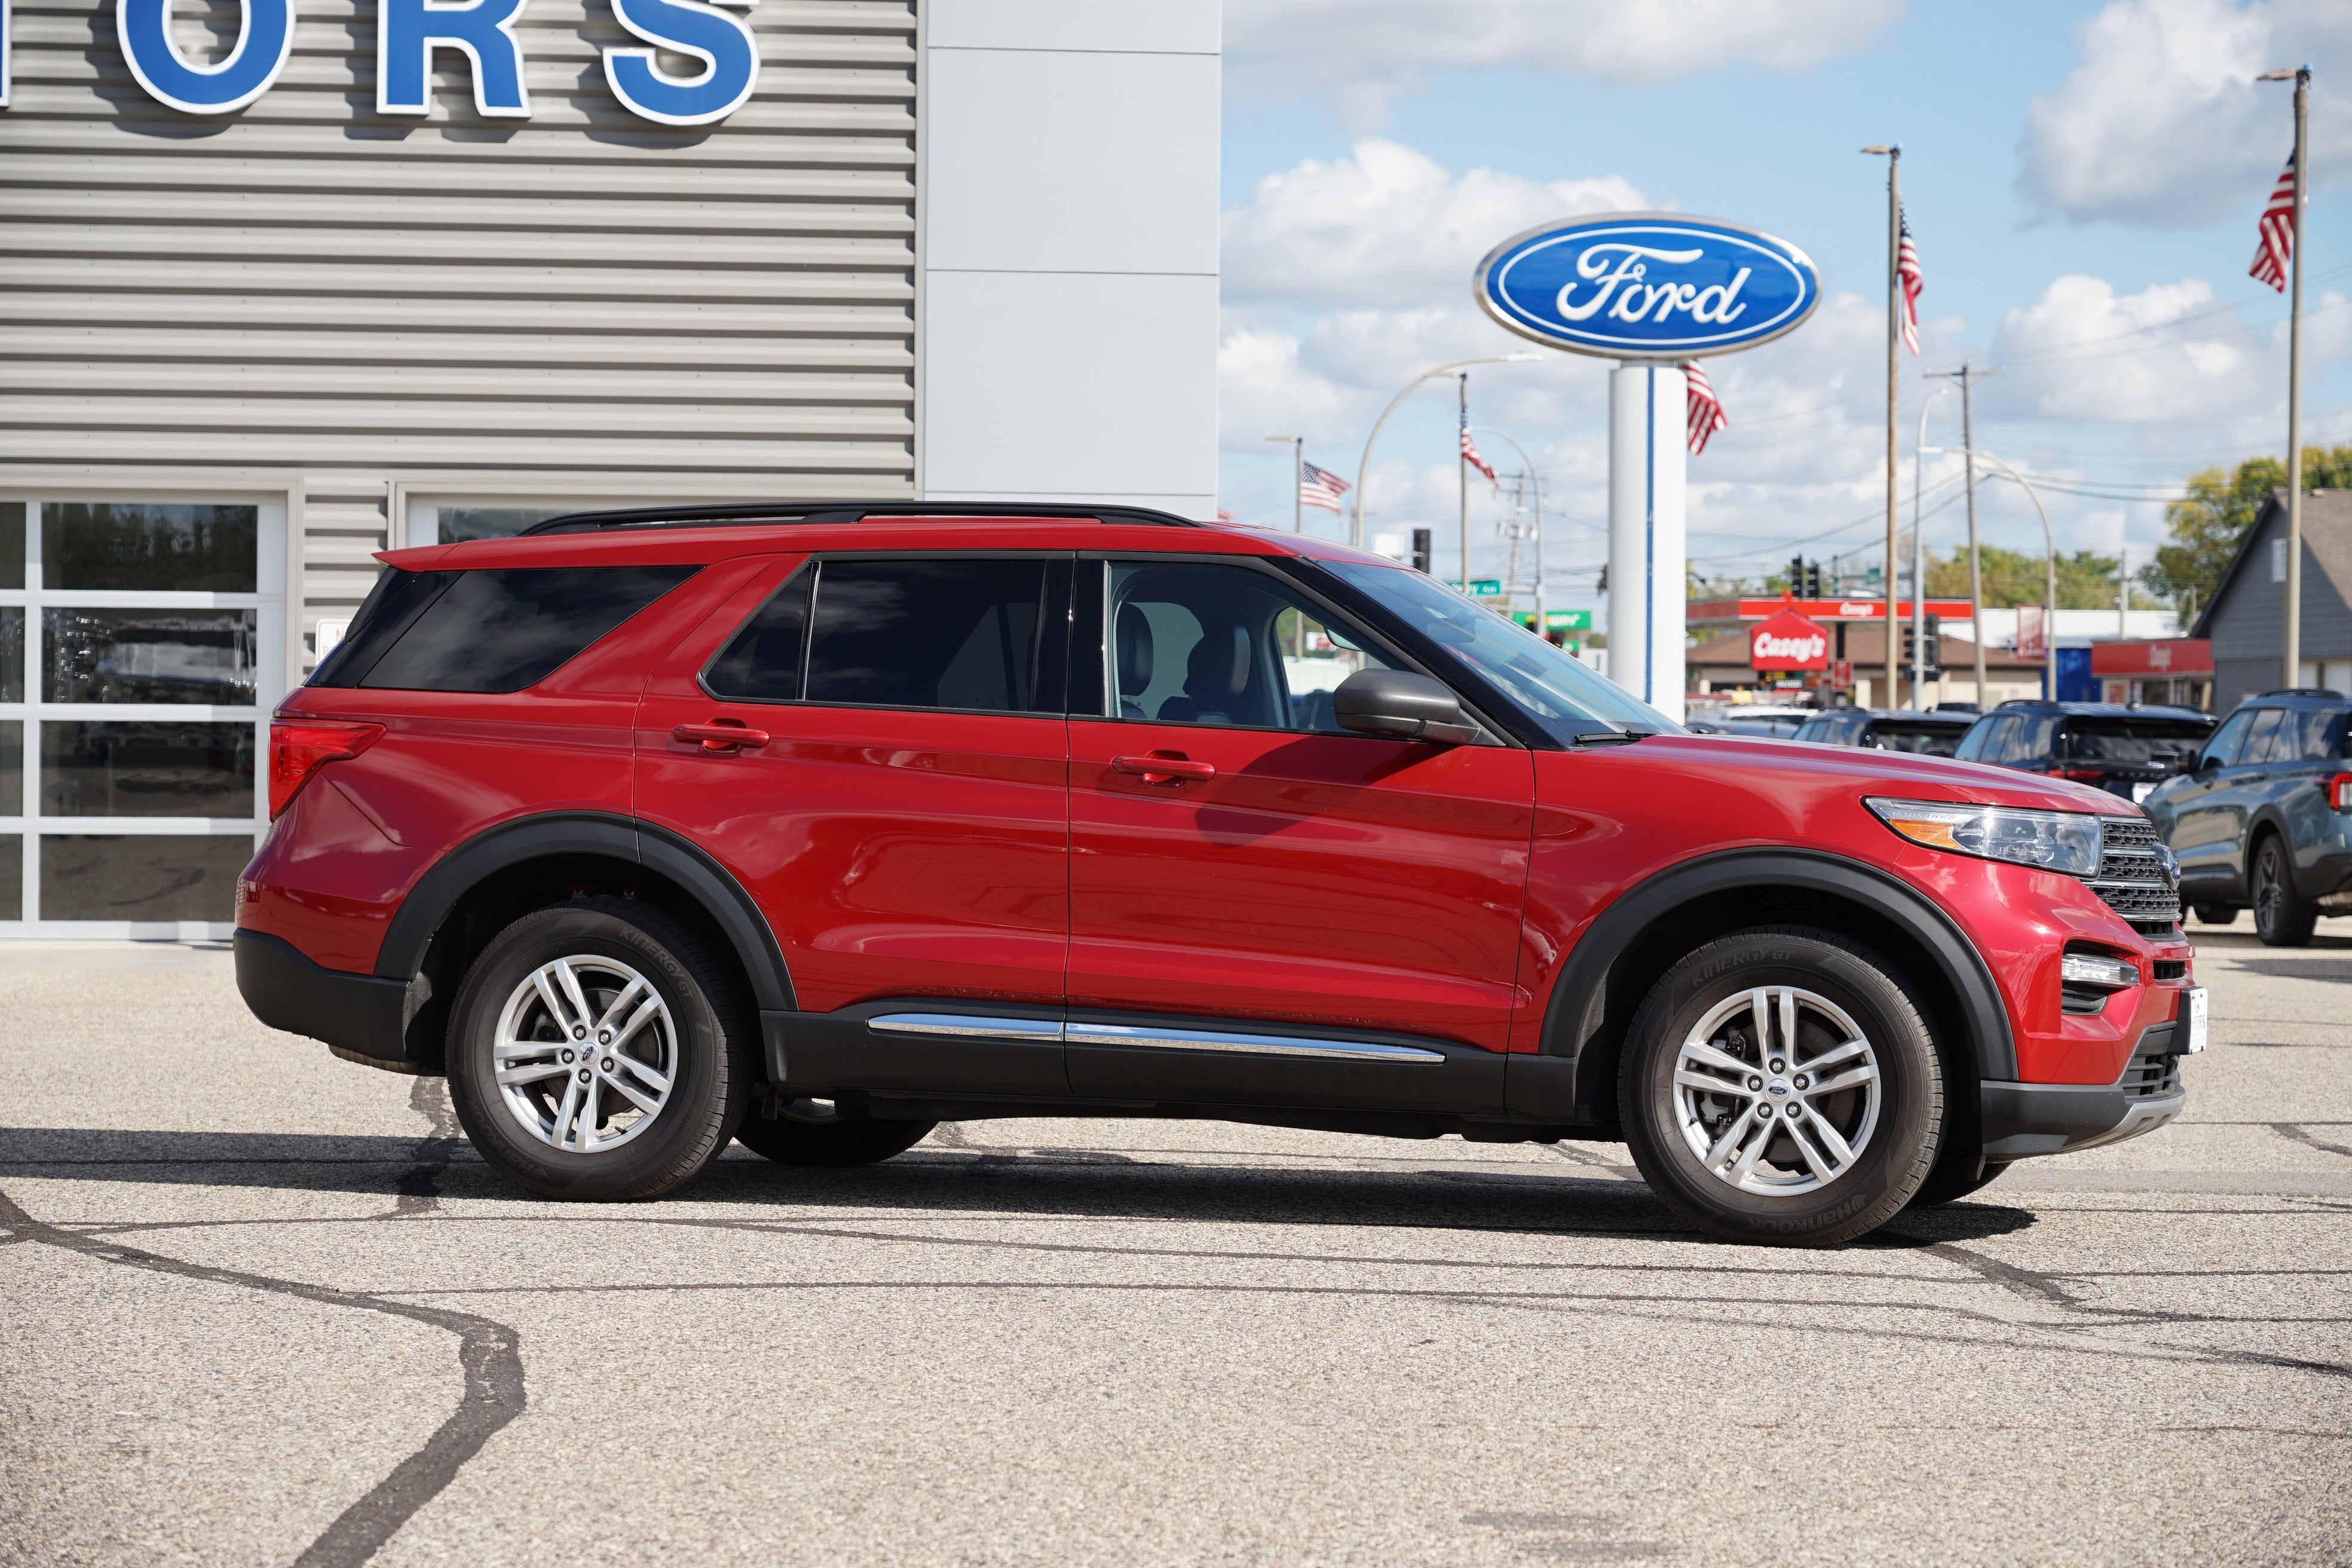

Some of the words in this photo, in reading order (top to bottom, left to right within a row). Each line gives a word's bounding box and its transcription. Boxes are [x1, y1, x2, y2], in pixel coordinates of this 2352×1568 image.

[0, 0, 761, 125] ORS
[1556, 243, 1752, 325] Ford
[1754, 632, 1826, 663] Casey's
[1772, 950, 1794, 961] GT
